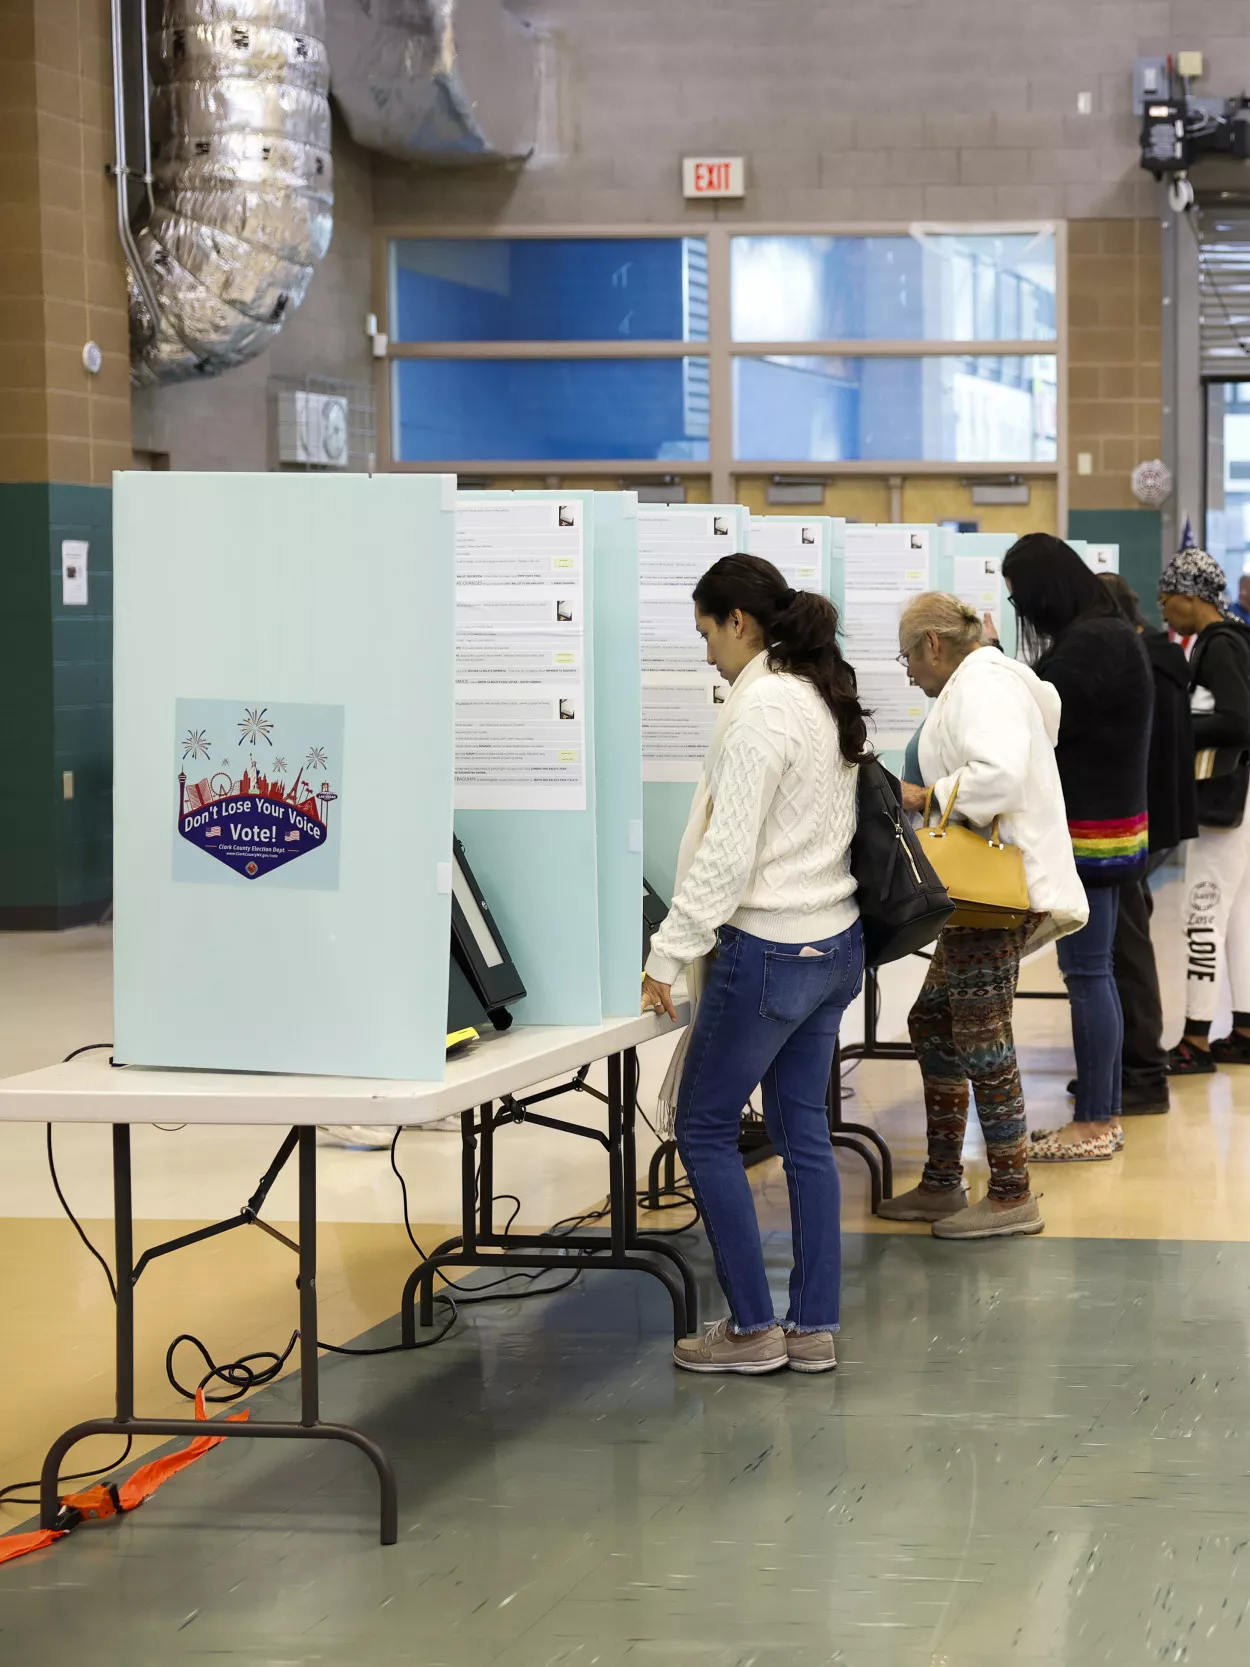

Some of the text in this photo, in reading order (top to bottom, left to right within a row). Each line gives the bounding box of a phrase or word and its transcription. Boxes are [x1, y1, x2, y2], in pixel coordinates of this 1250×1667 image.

[695, 163, 732, 191] EXIT
[184, 798, 321, 839] Don't Lose Your Voice
[230, 823, 276, 842] Vote!
[1187, 927, 1216, 982] LOVE
